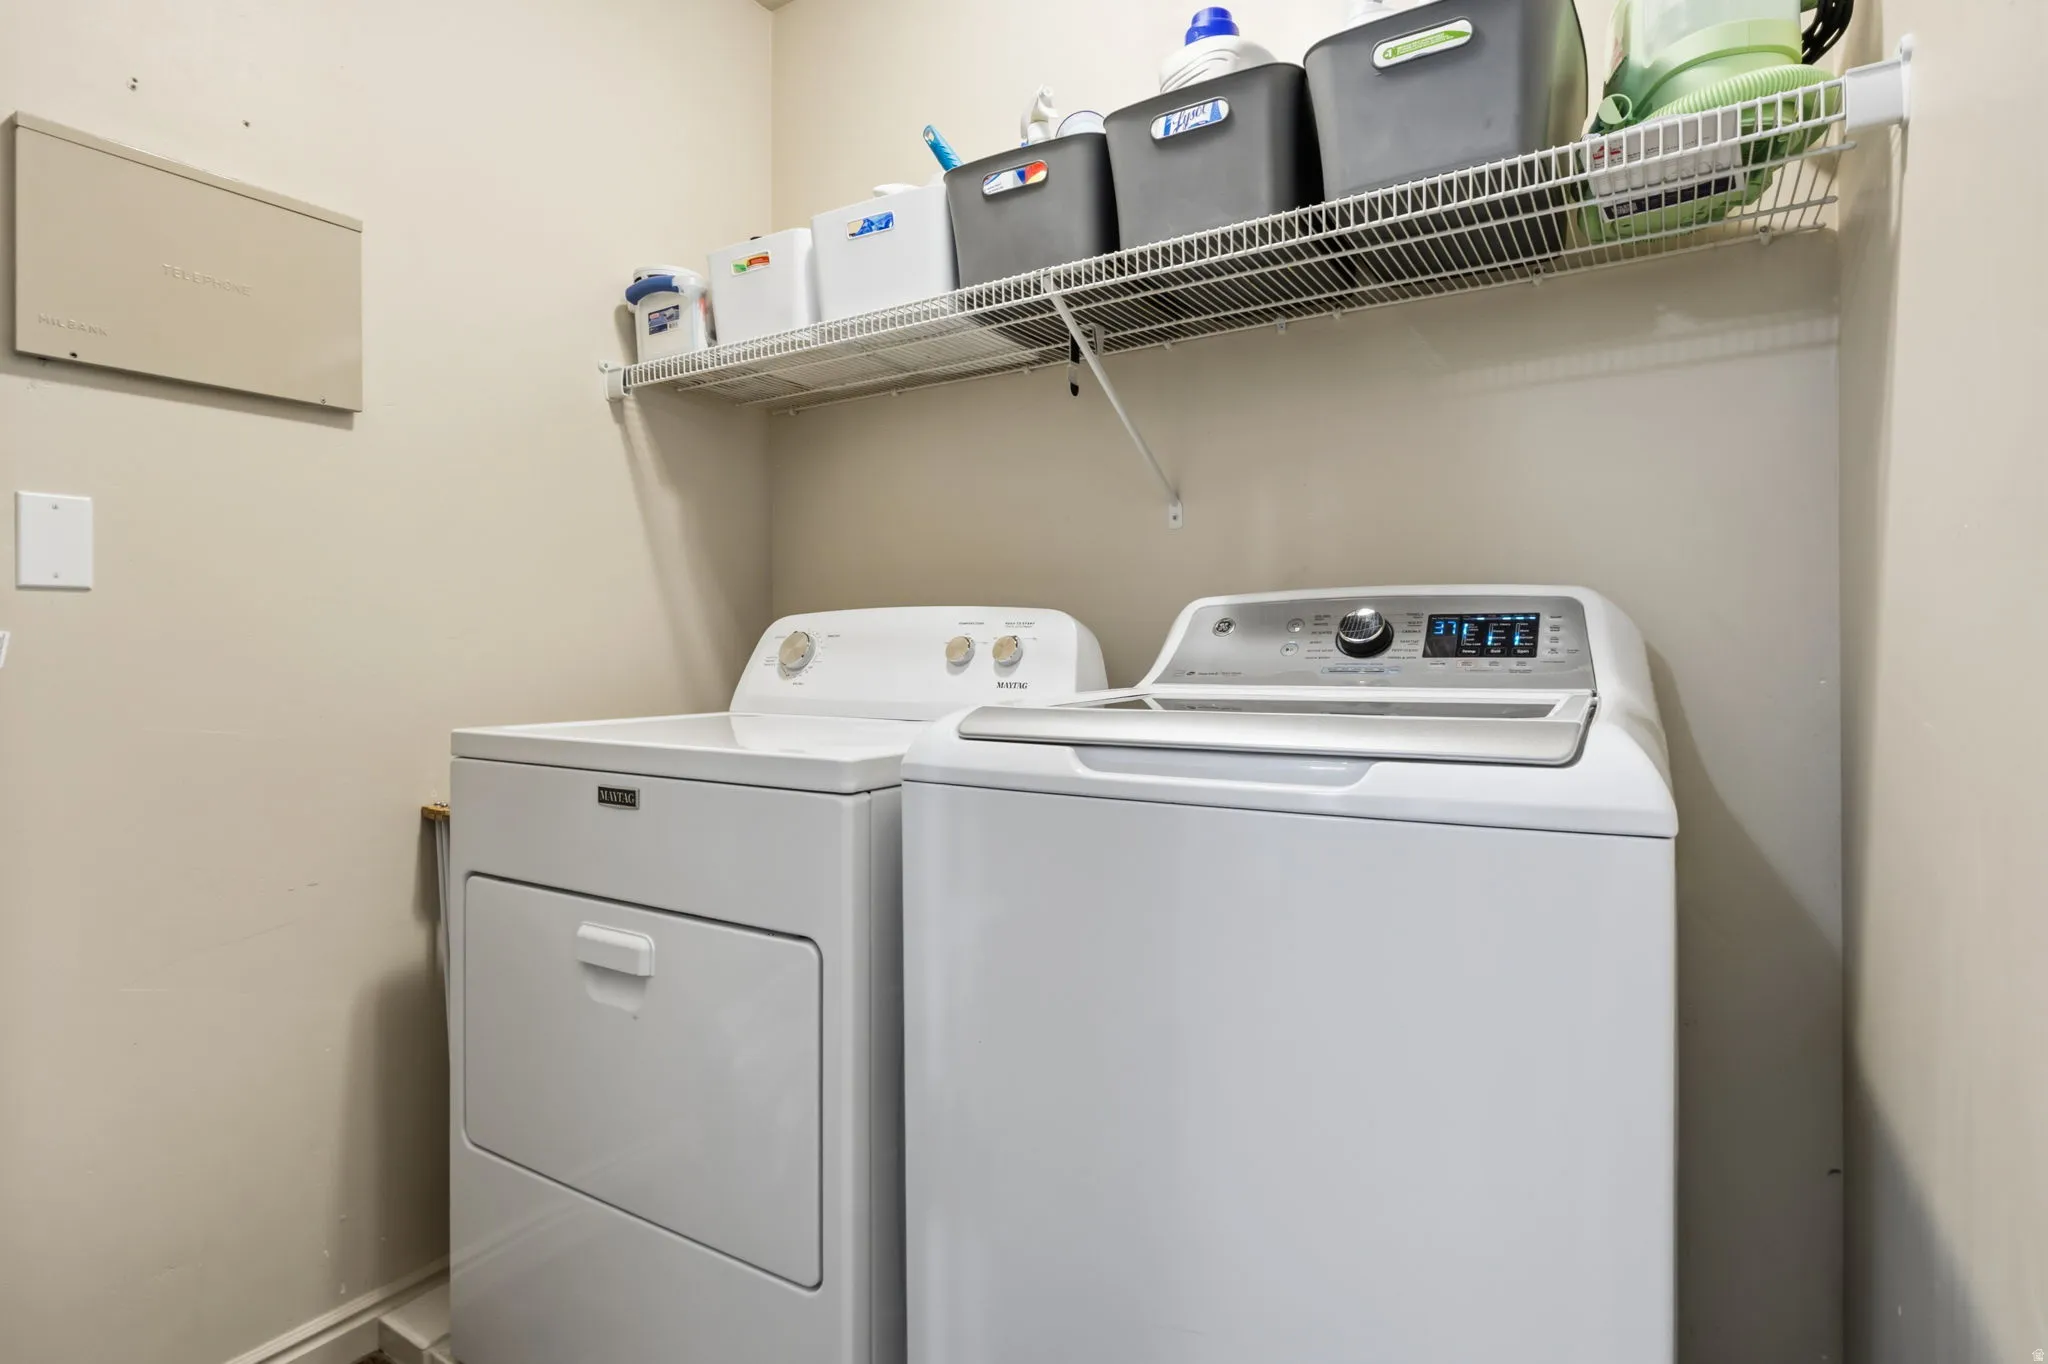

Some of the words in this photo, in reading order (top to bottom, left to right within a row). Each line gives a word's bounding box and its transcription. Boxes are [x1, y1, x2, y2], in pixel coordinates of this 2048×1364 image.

[162, 263, 252, 297] TELEPHONE
[37, 312, 108, 337] MILBANK
[1433, 620, 1457, 635] 37
[996, 681, 1028, 689] MAYTAG
[599, 790, 635, 804] MAYTAG
